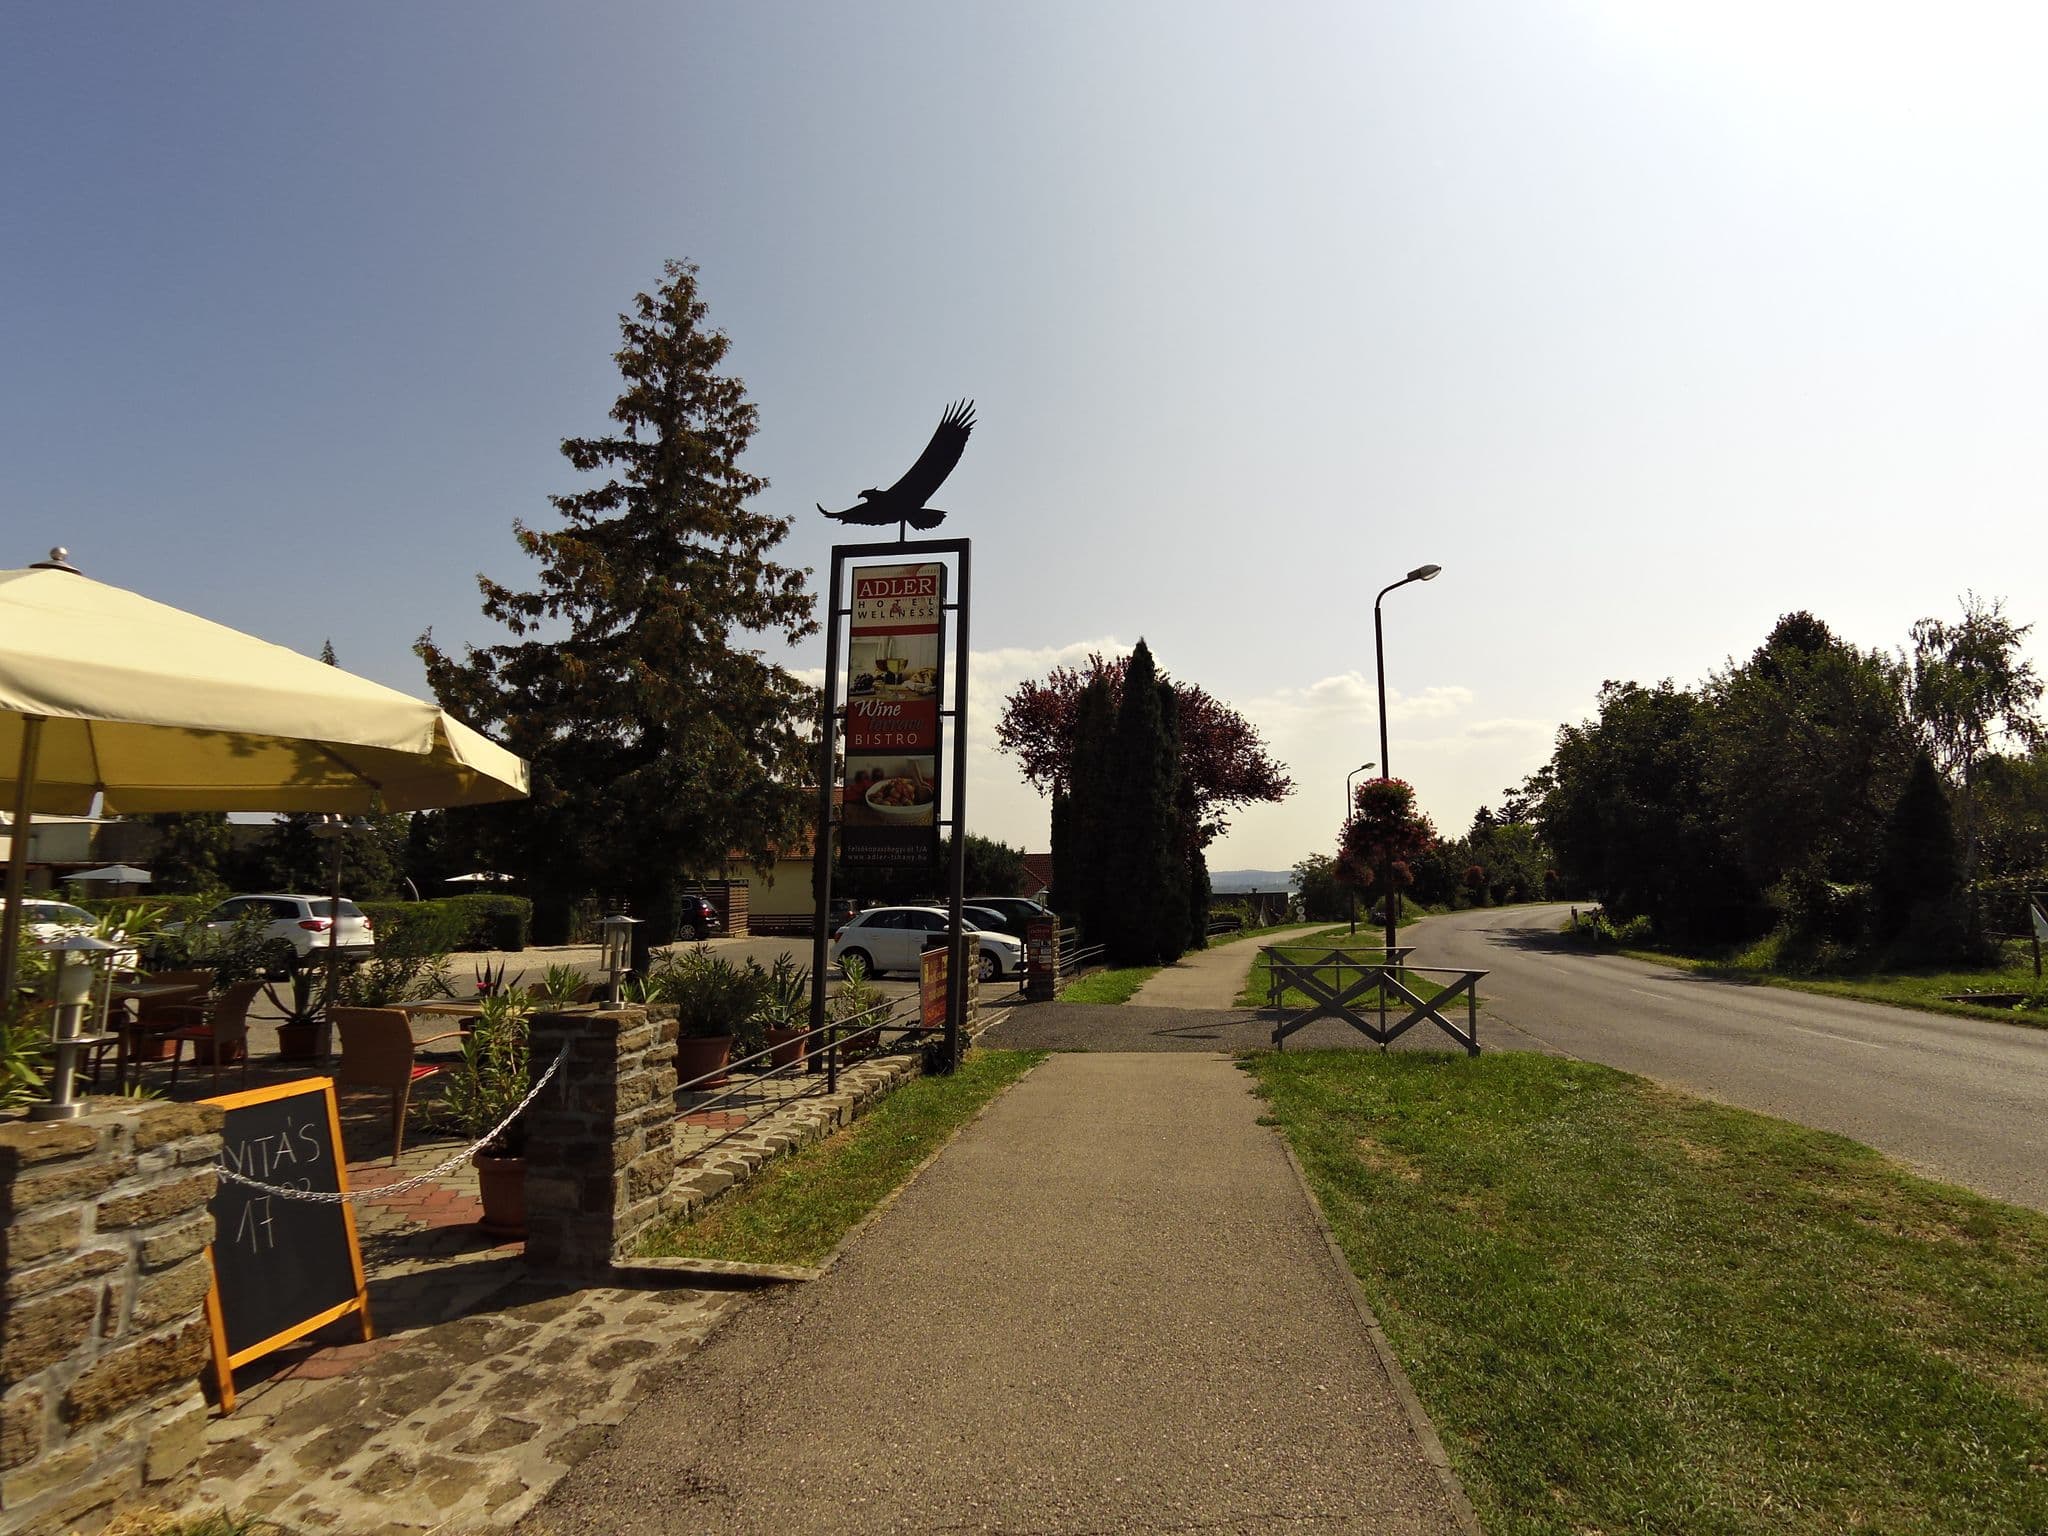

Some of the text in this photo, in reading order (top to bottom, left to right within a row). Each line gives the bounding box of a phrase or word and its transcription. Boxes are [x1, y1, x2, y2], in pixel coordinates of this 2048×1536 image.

[860, 578, 933, 597] ADLER
[858, 598, 934, 609] HOTEL
[858, 607, 935, 619] WELLNESS
[854, 699, 902, 717] Wine
[855, 733, 918, 745] BISTRO
